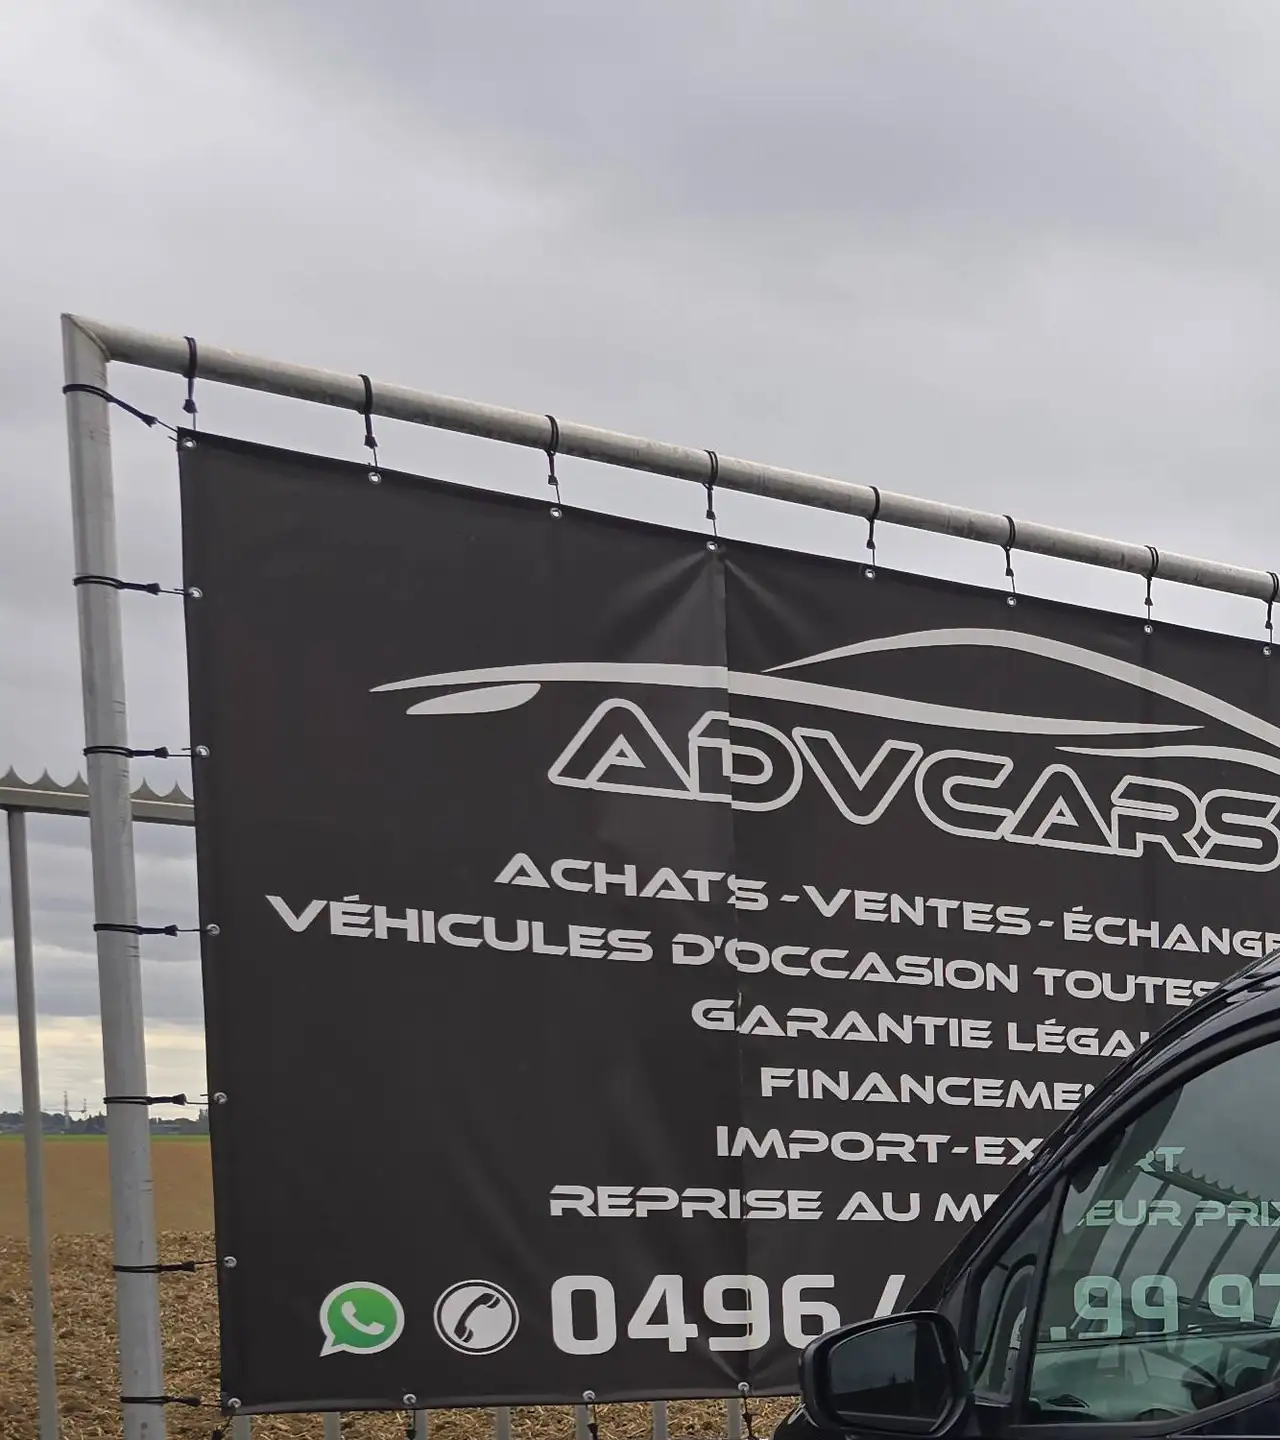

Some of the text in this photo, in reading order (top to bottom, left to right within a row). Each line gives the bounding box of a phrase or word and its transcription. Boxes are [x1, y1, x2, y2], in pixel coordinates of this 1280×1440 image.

[494, 852, 768, 911] ACHATS
[266, 894, 653, 962] VÉHICULES
[672, 933, 1018, 993] D'OCCASION
[691, 999, 993, 1049] GARANTIE
[760, 1067, 1095, 1111] FINANCEME
[549, 1185, 823, 1221] REPRISE
[837, 1190, 920, 1222] AU
[1077, 1199, 1182, 1227] EUR
